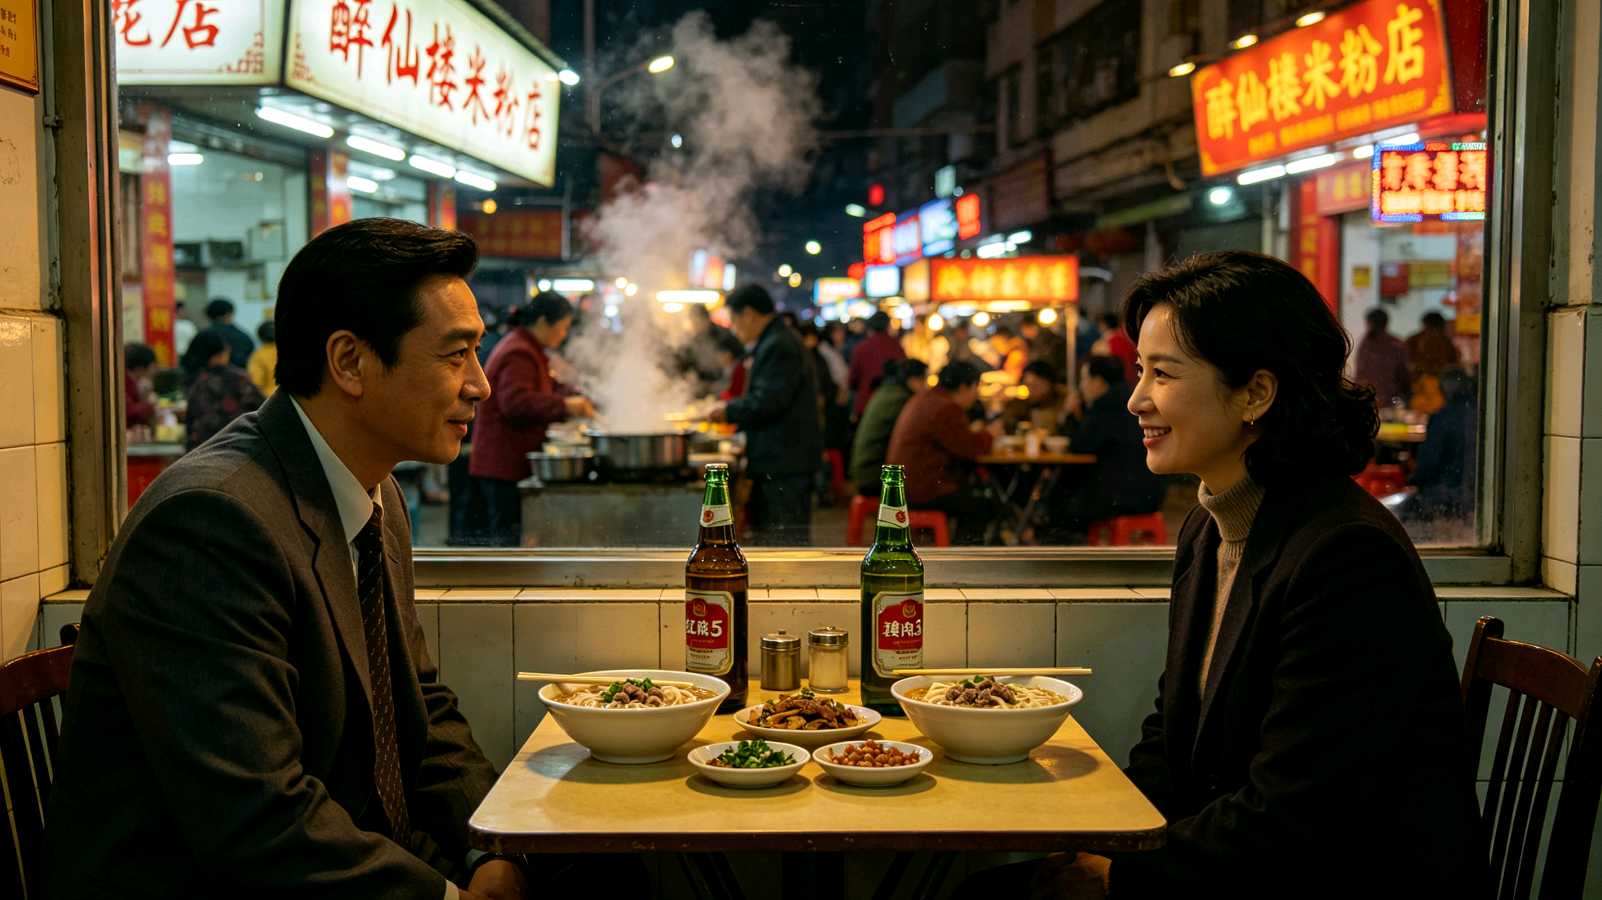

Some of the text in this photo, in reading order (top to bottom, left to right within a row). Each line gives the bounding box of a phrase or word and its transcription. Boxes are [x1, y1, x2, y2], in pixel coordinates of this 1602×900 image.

[330, 0, 542, 151] 醉仙楼米粉店
